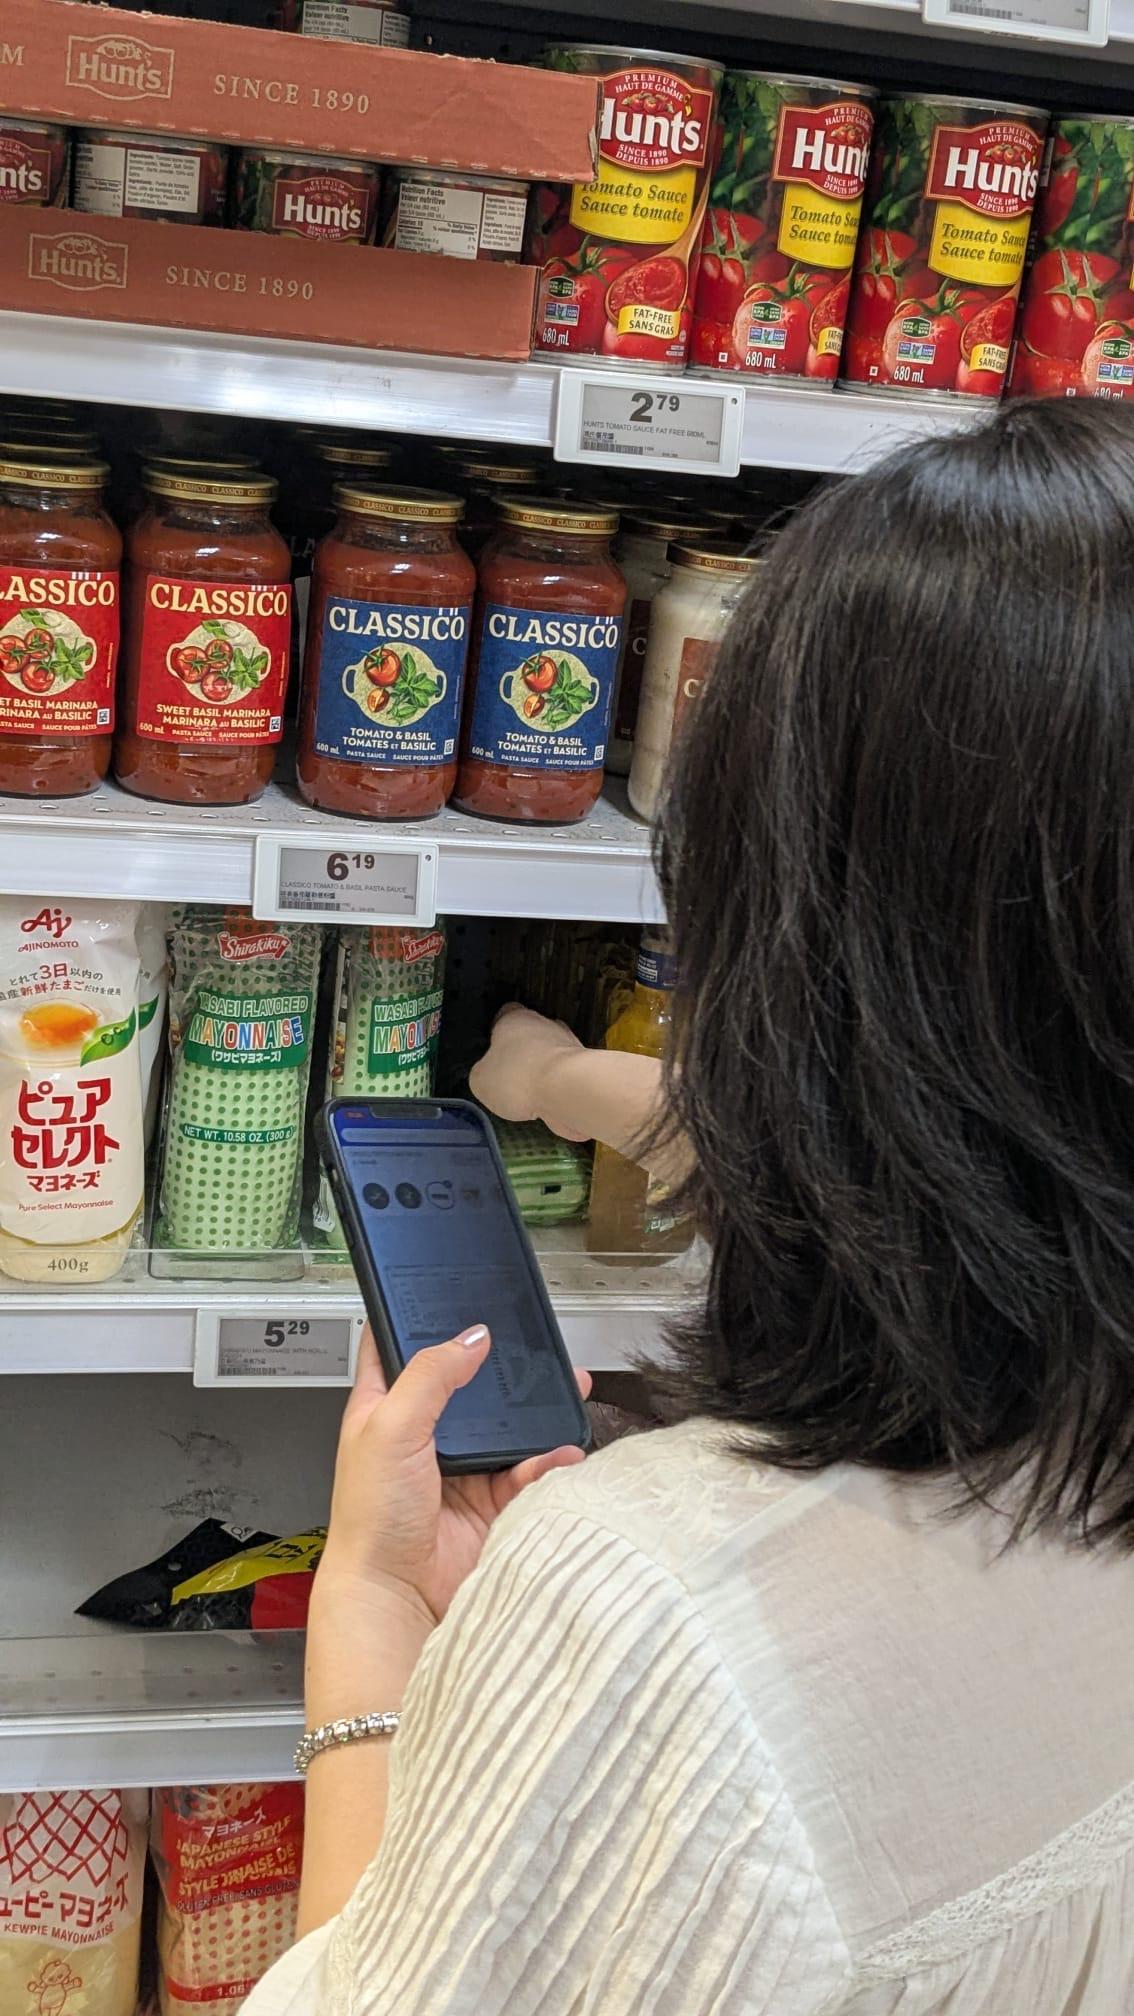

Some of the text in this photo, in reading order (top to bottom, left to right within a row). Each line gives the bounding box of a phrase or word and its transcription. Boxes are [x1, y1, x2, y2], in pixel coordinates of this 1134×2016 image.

[78, 51, 163, 91] Hunt's
[625, 72, 678, 88] PREMIUM
[214, 74, 370, 115] SINCE 1890
[615, 82, 638, 93] HAUT
[655, 83, 684, 101] GAMME
[825, 115, 845, 126] HAUT
[980, 134, 1012, 145] HAUT DE
[989, 127, 1031, 140] PREMIUM
[616, 151, 668, 166] DEPUIS 1890
[618, 143, 667, 157] SINCE 1890
[825, 174, 847, 187] SINCE
[944, 146, 1039, 202] Hunt's
[581, 182, 688, 204] Tomato Sauce
[823, 182, 847, 195] DEPUIS
[977, 200, 1019, 213] DEPUIS 1890
[980, 192, 1019, 205] SINCE 1890
[283, 194, 362, 231] Hunt's
[580, 196, 685, 222] Sauce tomate
[790, 205, 842, 225] Tomato
[789, 224, 831, 243] Sauce
[942, 222, 1026, 248] Tomato Sauce
[940, 241, 1023, 265] Sauce tomate
[40, 248, 120, 282] Hunt's
[166, 265, 313, 300] SINCE 1890
[633, 308, 673, 324] FAT-FREE
[629, 319, 675, 336] SANS GRAS
[542, 327, 570, 346] 680 mL
[745, 351, 776, 369] 680 mL
[893, 365, 925, 384] 680 mL
[605, 422, 632, 432] TOMATO
[632, 424, 654, 434] SAUCE
[669, 428, 685, 437] FREE
[151, 583, 288, 618] CLASSICO
[328, 606, 465, 641] CLASSICO
[488, 613, 618, 649] CLASSICO
[13, 699, 98, 710] BASIL MARINARA
[156, 704, 271, 718] SWEET BASIL MARINARA
[54, 711, 93, 720] BASILIC
[162, 716, 266, 728] MARINARA AU BASILIC
[139, 722, 153, 731] 600
[350, 727, 432, 741] TOMATO & BASIL
[316, 742, 329, 752] 600
[342, 736, 389, 749] TOMATES
[400, 741, 437, 751] BASILIC
[506, 732, 583, 746] TOMATO & BASIL
[346, 750, 386, 759] PASTA SAUCE
[471, 746, 484, 756] 600
[497, 741, 542, 754] TOMATES
[553, 746, 588, 756] BASILIC
[501, 754, 540, 764] PASTA SAUCE
[279, 881, 312, 889] CLASSICO
[313, 882, 339, 890] TOMATO
[18, 940, 79, 952] AJINOMOTO
[224, 938, 282, 958] Shirakiku
[9, 962, 104, 986] とれて3日以内の
[242, 995, 309, 1018] FLAVORED
[374, 999, 418, 1022] WASABI
[189, 1012, 305, 1051] MAYONNAISE
[211, 1049, 281, 1063] (ワサビマヨネーズ)
[18, 1077, 112, 1126] ピュア
[184, 1124, 202, 1138] NET
[203, 1130, 221, 1140] WT.
[223, 1132, 246, 1142] 10.58
[266, 1130, 284, 1142] (300
[11, 1123, 120, 1169] セレクト
[27, 1170, 101, 1192] マヨネーズ
[19, 1199, 114, 1211] Pure Select Mayonnaise
[47, 1258, 89, 1273] 400g
[176, 1815, 292, 1857] JAPANESE STYLE
[178, 1874, 219, 1897] STYLE
[4, 1921, 116, 1945] KEWPIE MAYONNAISE
